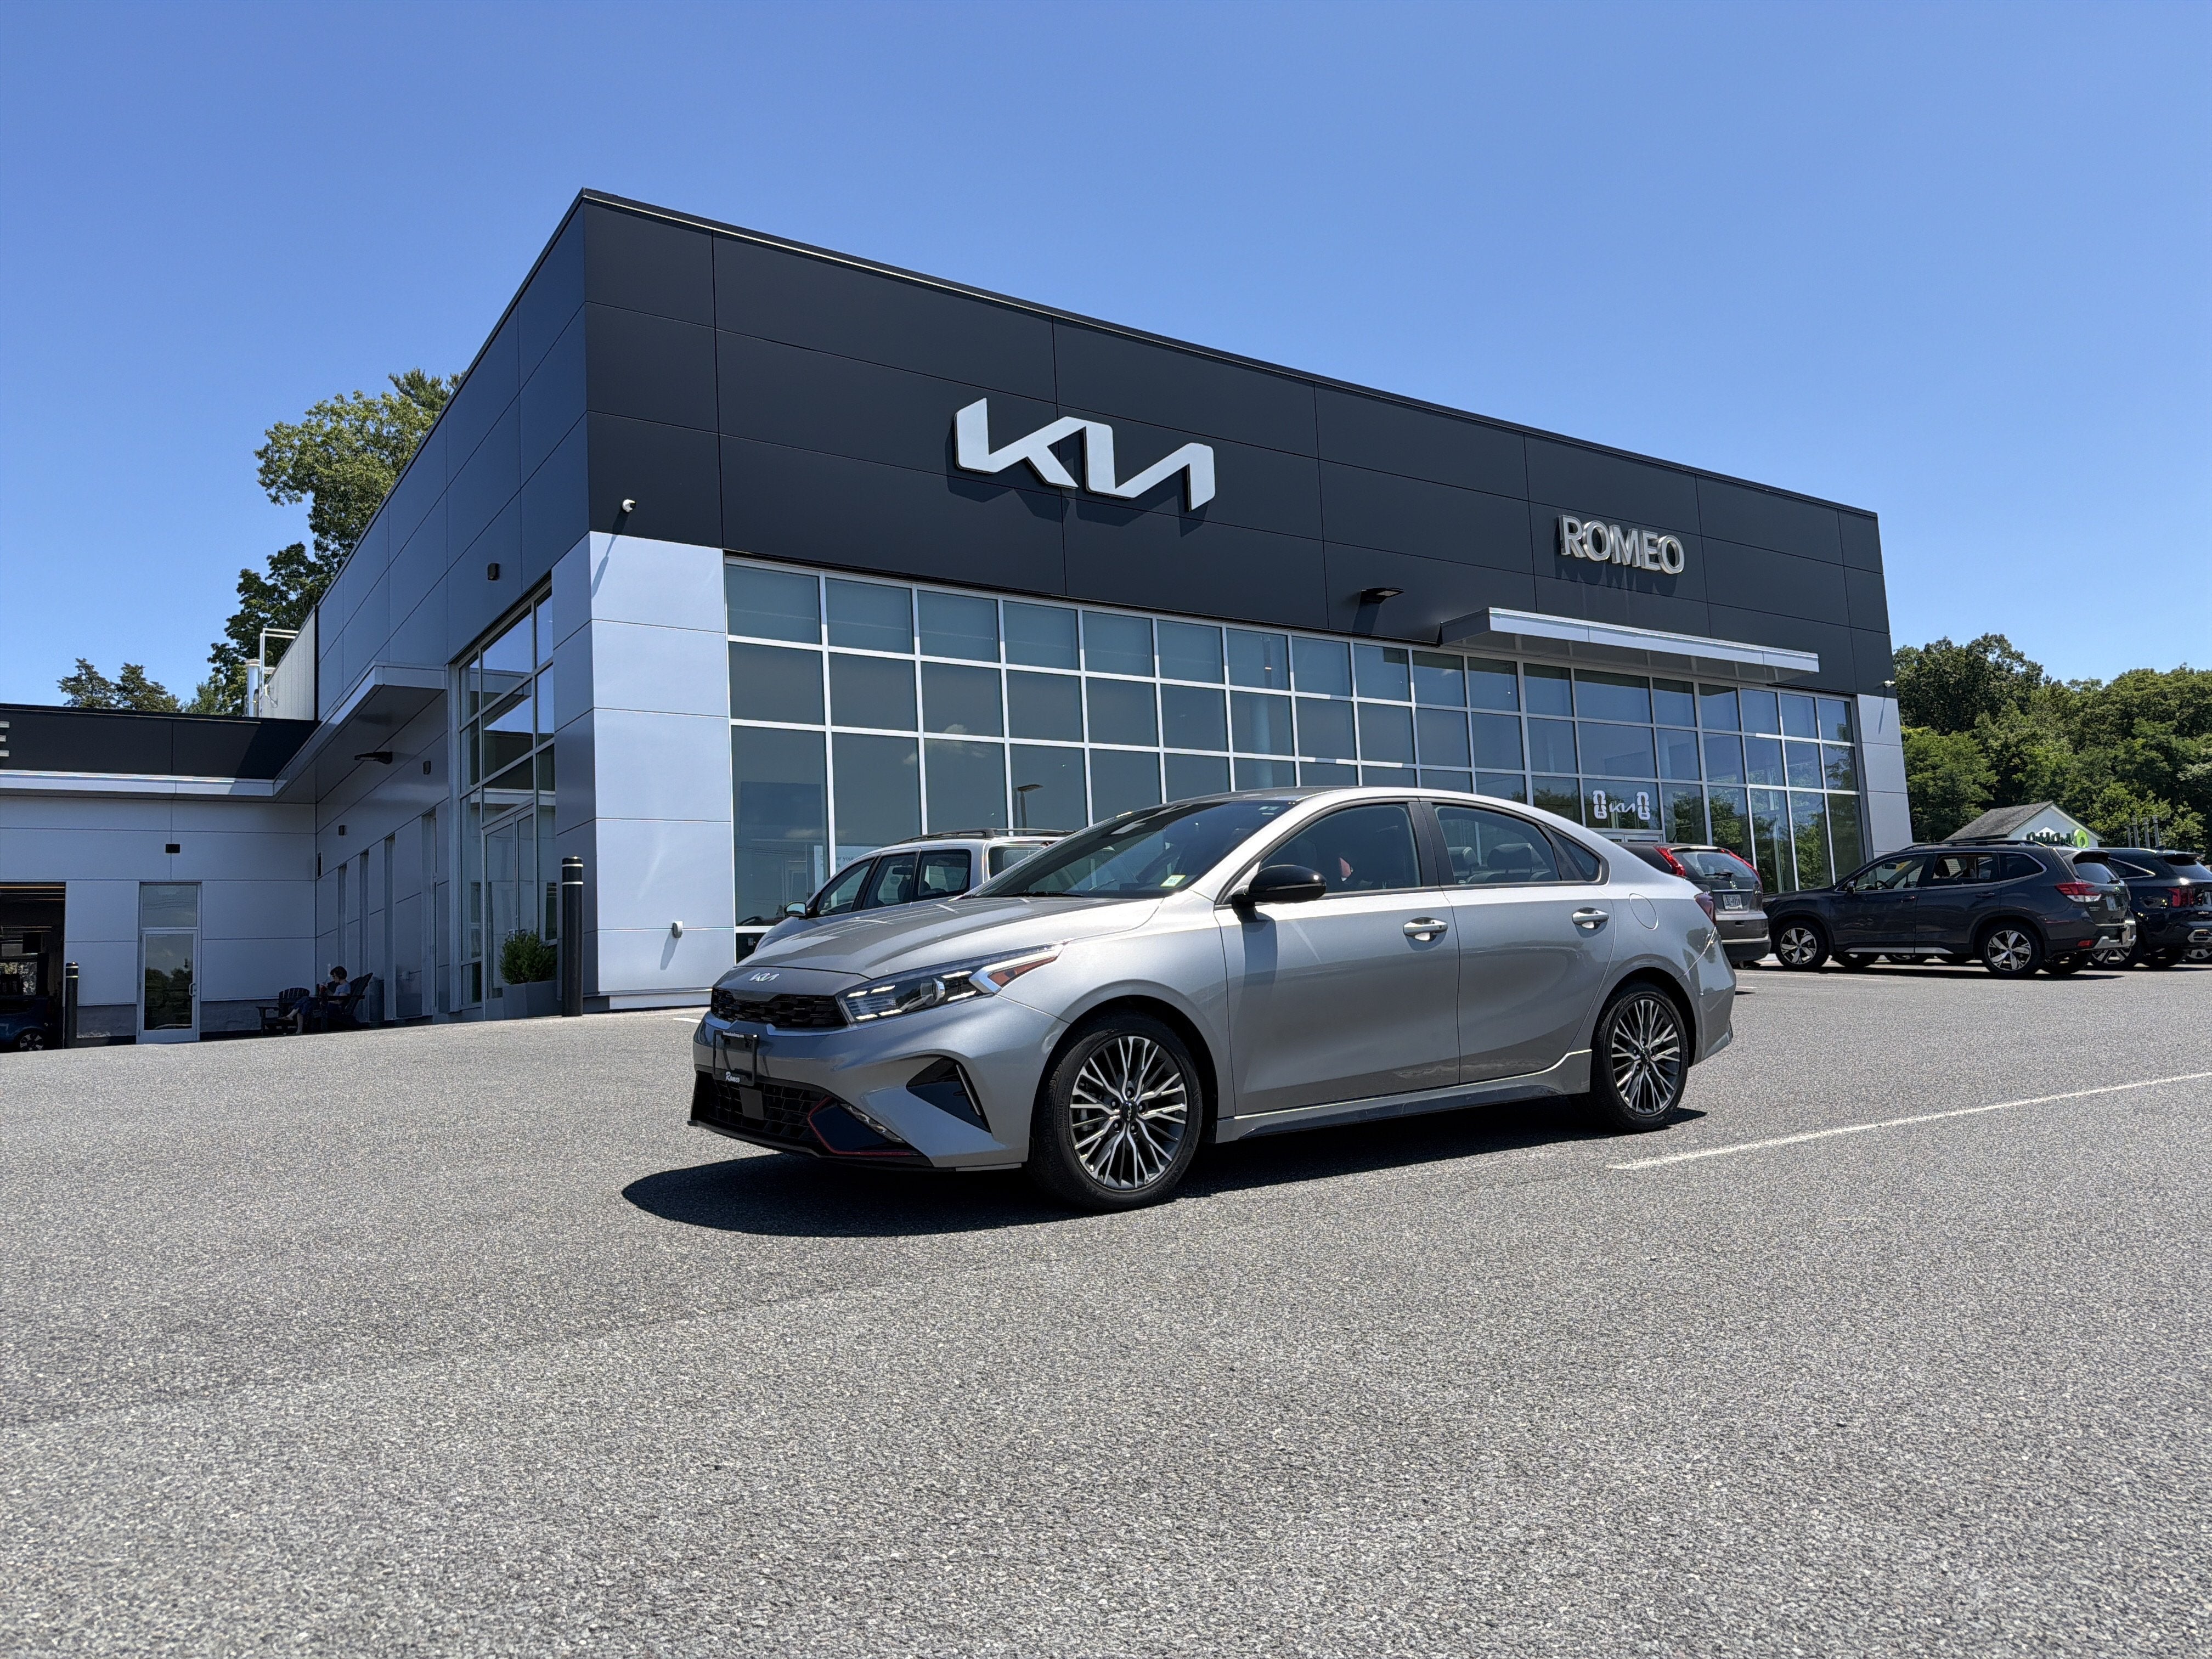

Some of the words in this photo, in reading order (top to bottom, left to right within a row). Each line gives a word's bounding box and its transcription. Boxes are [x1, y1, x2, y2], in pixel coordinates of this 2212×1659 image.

[955, 398, 1215, 511] KIA
[1559, 515, 1684, 574] ROMEO
[1609, 803, 1635, 813] KIA
